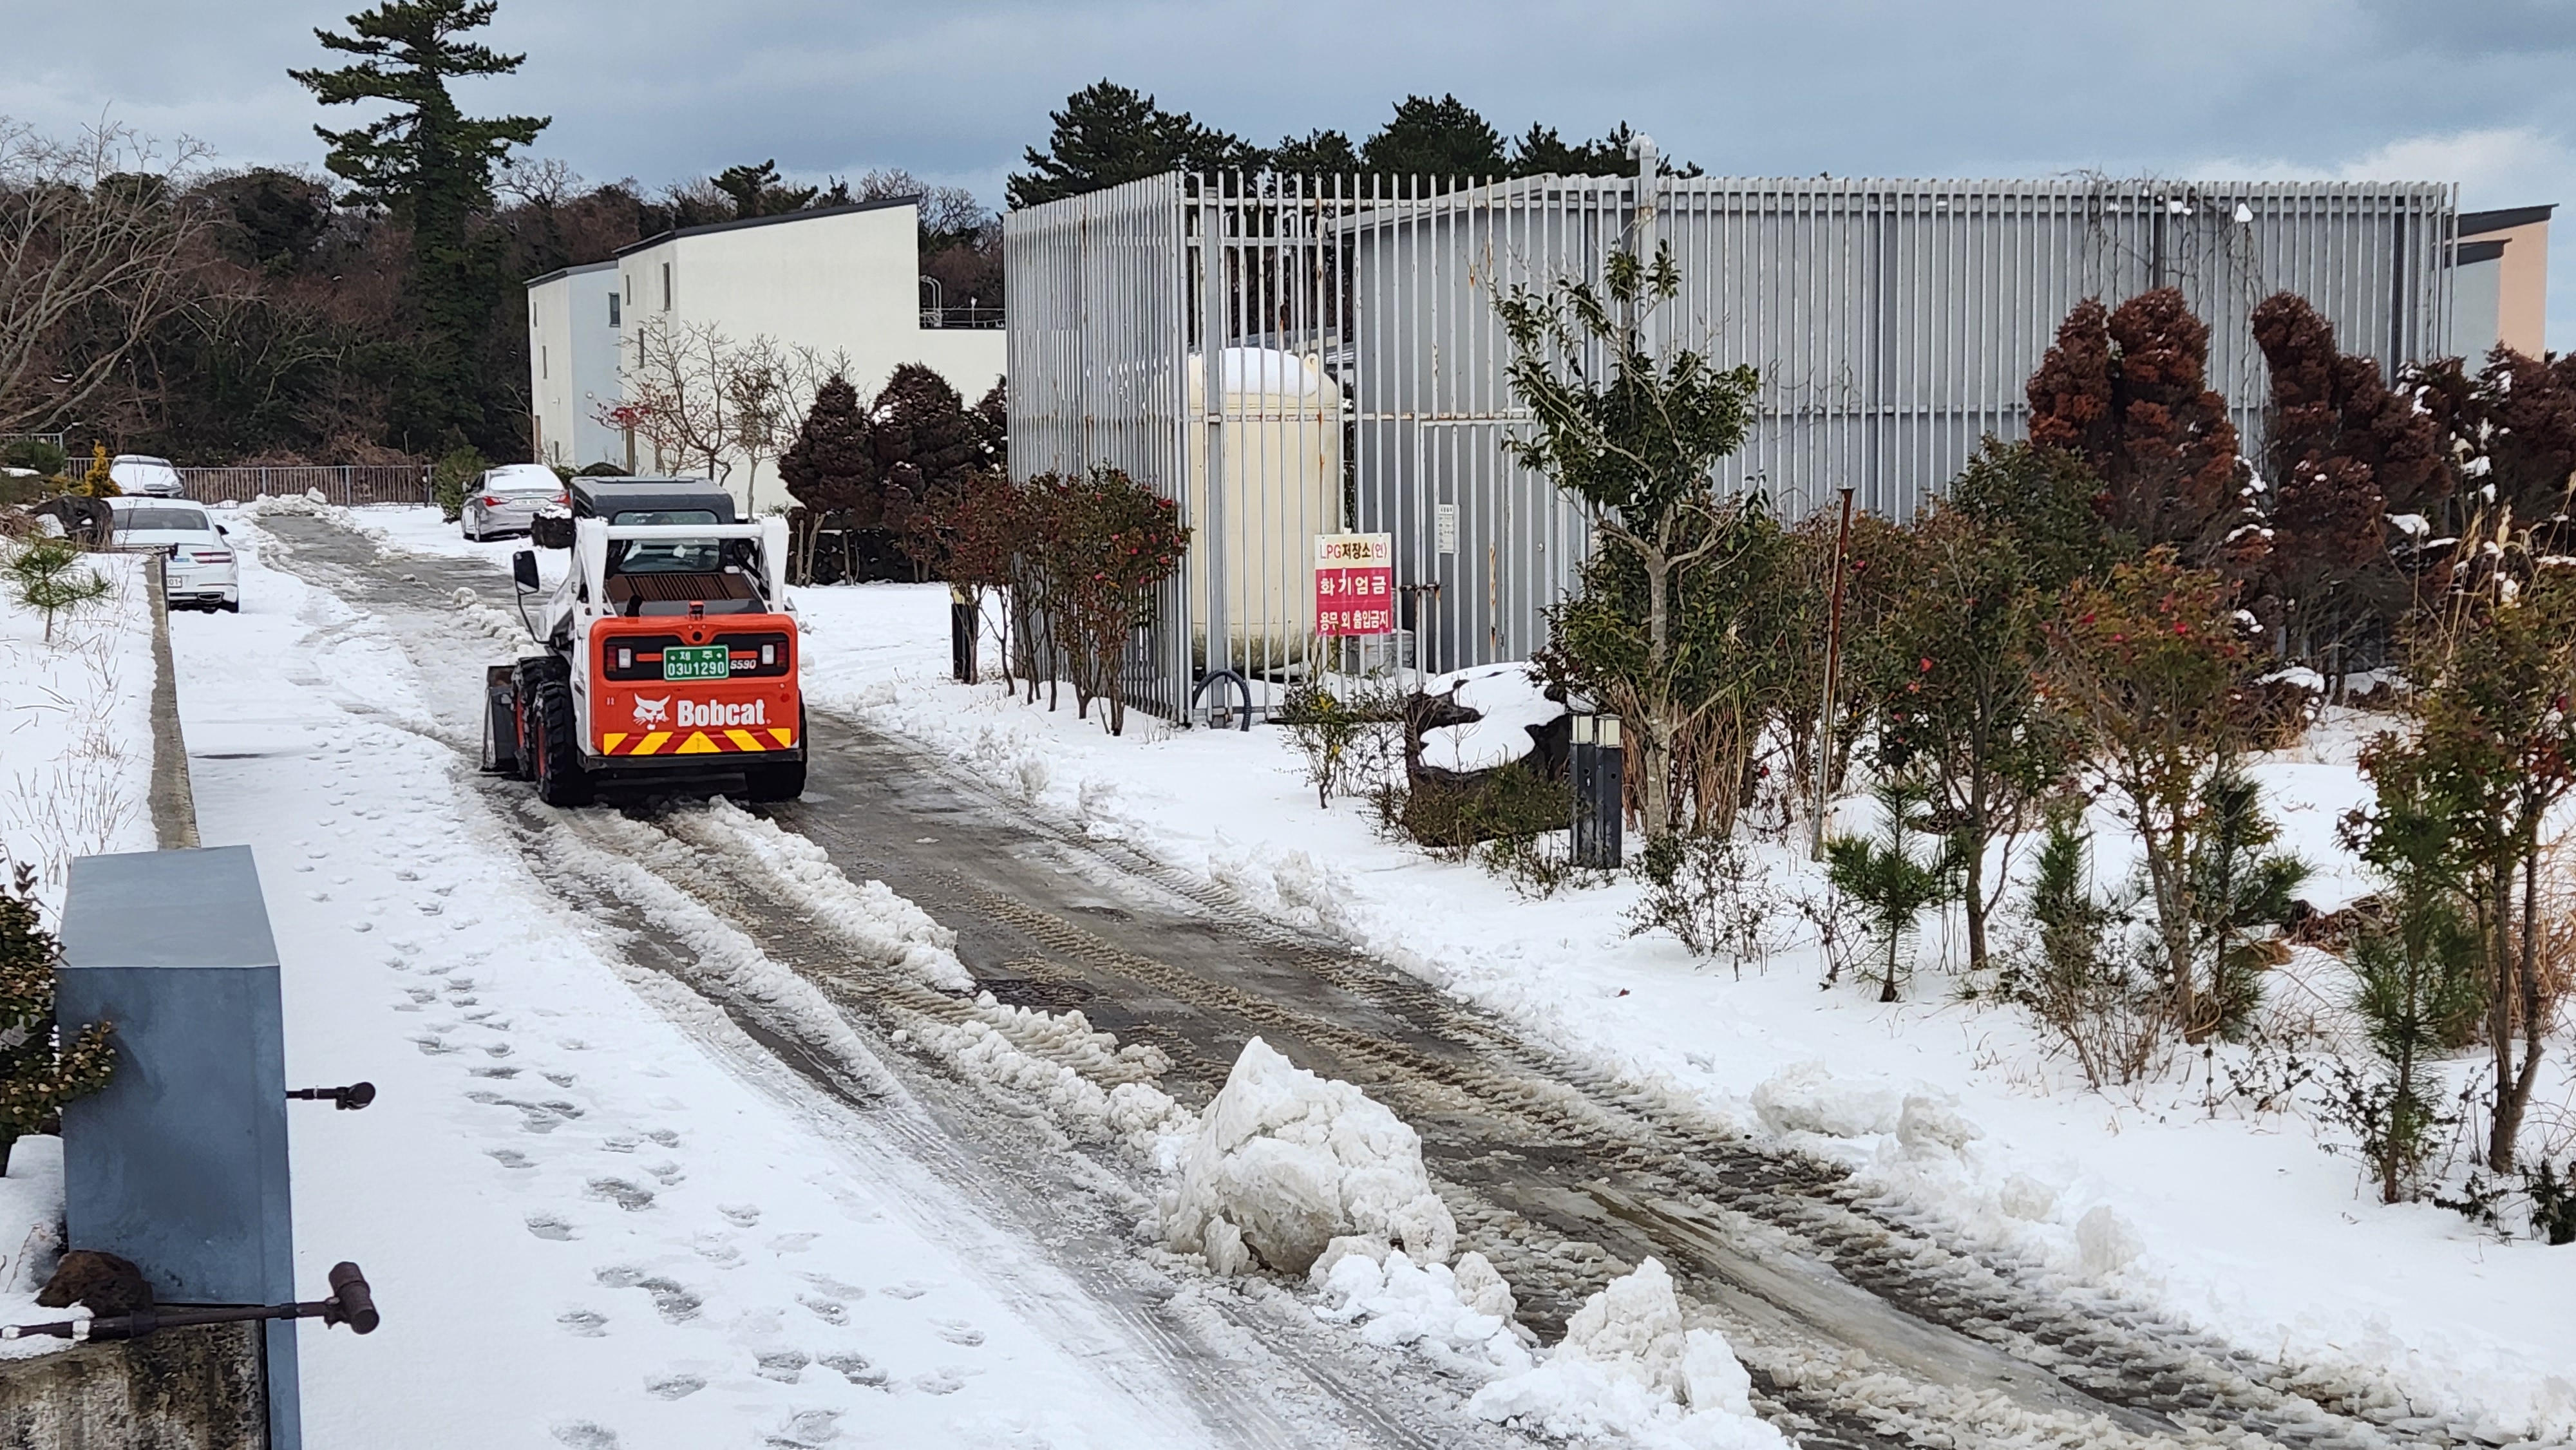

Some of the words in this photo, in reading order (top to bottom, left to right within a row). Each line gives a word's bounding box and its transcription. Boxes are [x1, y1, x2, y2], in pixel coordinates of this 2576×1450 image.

[1320, 611, 1339, 631] 용무
[1341, 610, 1351, 630] 외
[1353, 609, 1388, 629] 출입금지
[730, 659, 757, 670] S590
[677, 699, 764, 727] Bobcat
